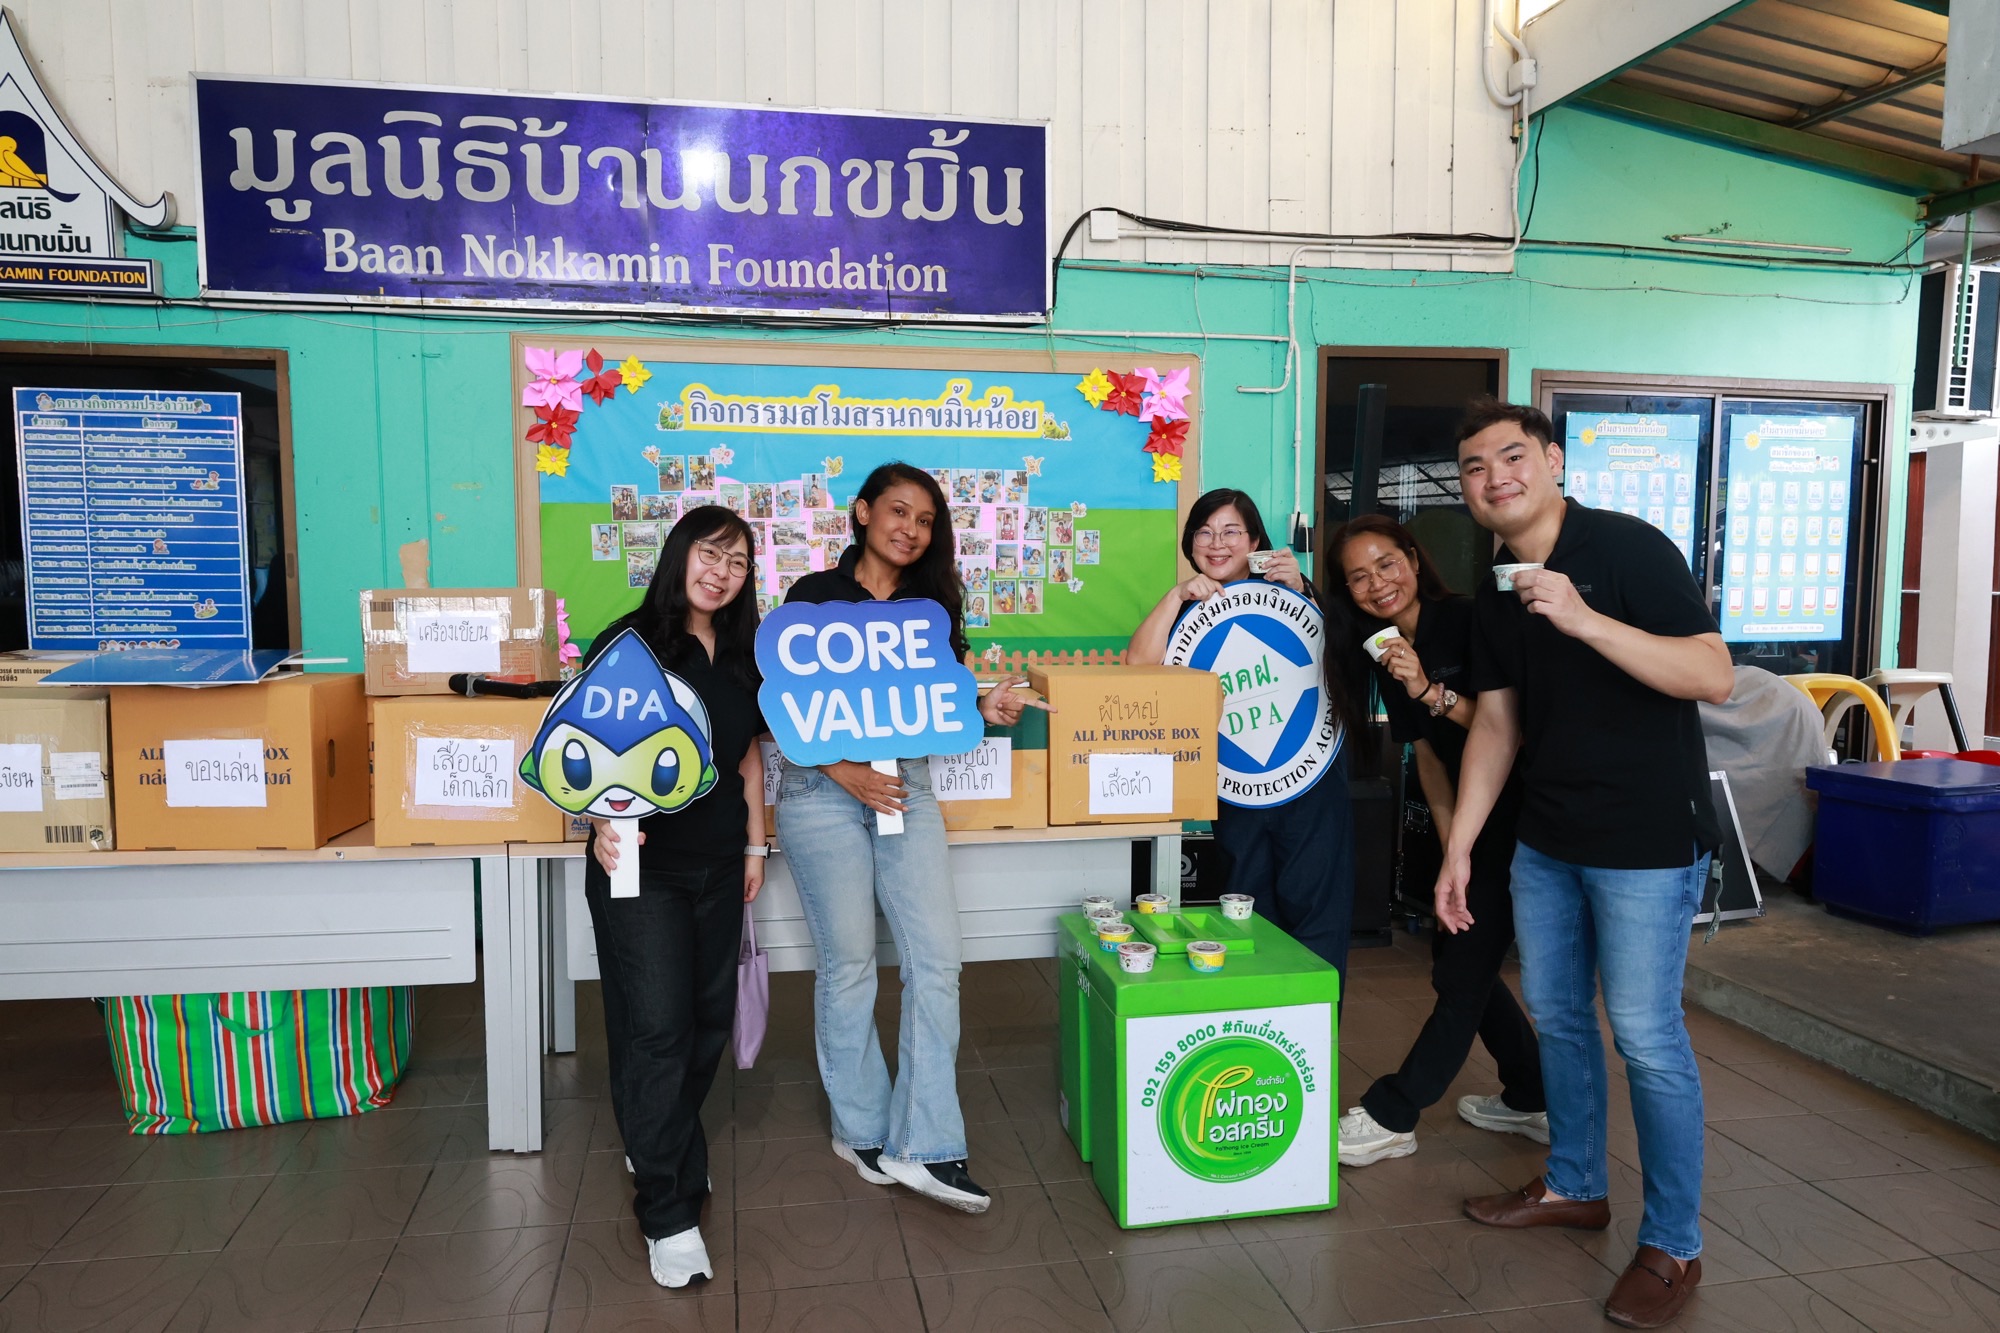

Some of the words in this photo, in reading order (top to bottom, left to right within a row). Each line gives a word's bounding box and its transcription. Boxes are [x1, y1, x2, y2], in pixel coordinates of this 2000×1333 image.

[229, 110, 1023, 226] มูลนิธิบ้านนกขมิ้น
[49, 269, 145, 284] FOUNDATION
[323, 228, 444, 276] Baan
[462, 233, 690, 284] Nokkamin
[708, 243, 948, 293] Foundation
[57, 395, 193, 412] ตารางกิจกรรมประจำวัน
[690, 385, 1038, 430] กิจกรรมสโมสรนกขมิ้นน้อย
[419, 620, 488, 642] เครื่องเขียน
[1172, 588, 1319, 666] ถาบันคุ้มครองเงินฝาก
[777, 619, 936, 676] CORE
[581, 685, 668, 722] DPA
[781, 682, 963, 743] VALUE
[1226, 701, 1284, 736] DPA
[1073, 730, 1098, 741] ALL
[1103, 728, 1166, 741] PURPOSE
[1171, 727, 1200, 739] BOX
[1222, 754, 1317, 797] PROTECTION
[1316, 692, 1333, 754] AGEN
[185, 752, 259, 783] ของเล่น
[263, 747, 290, 760] OX
[433, 741, 498, 773] เสื้อผ้า
[443, 772, 508, 798] เด็กเล็ก
[940, 764, 993, 792] เด็กโต
[1102, 767, 1151, 798] เสื้อผ้า
[1142, 1078, 1160, 1107] 092
[1155, 1051, 1176, 1074] 159
[1177, 1025, 1216, 1052] 8000
[1222, 1020, 1316, 1093] #กินเมื่อไหร่ก็อร่อย
